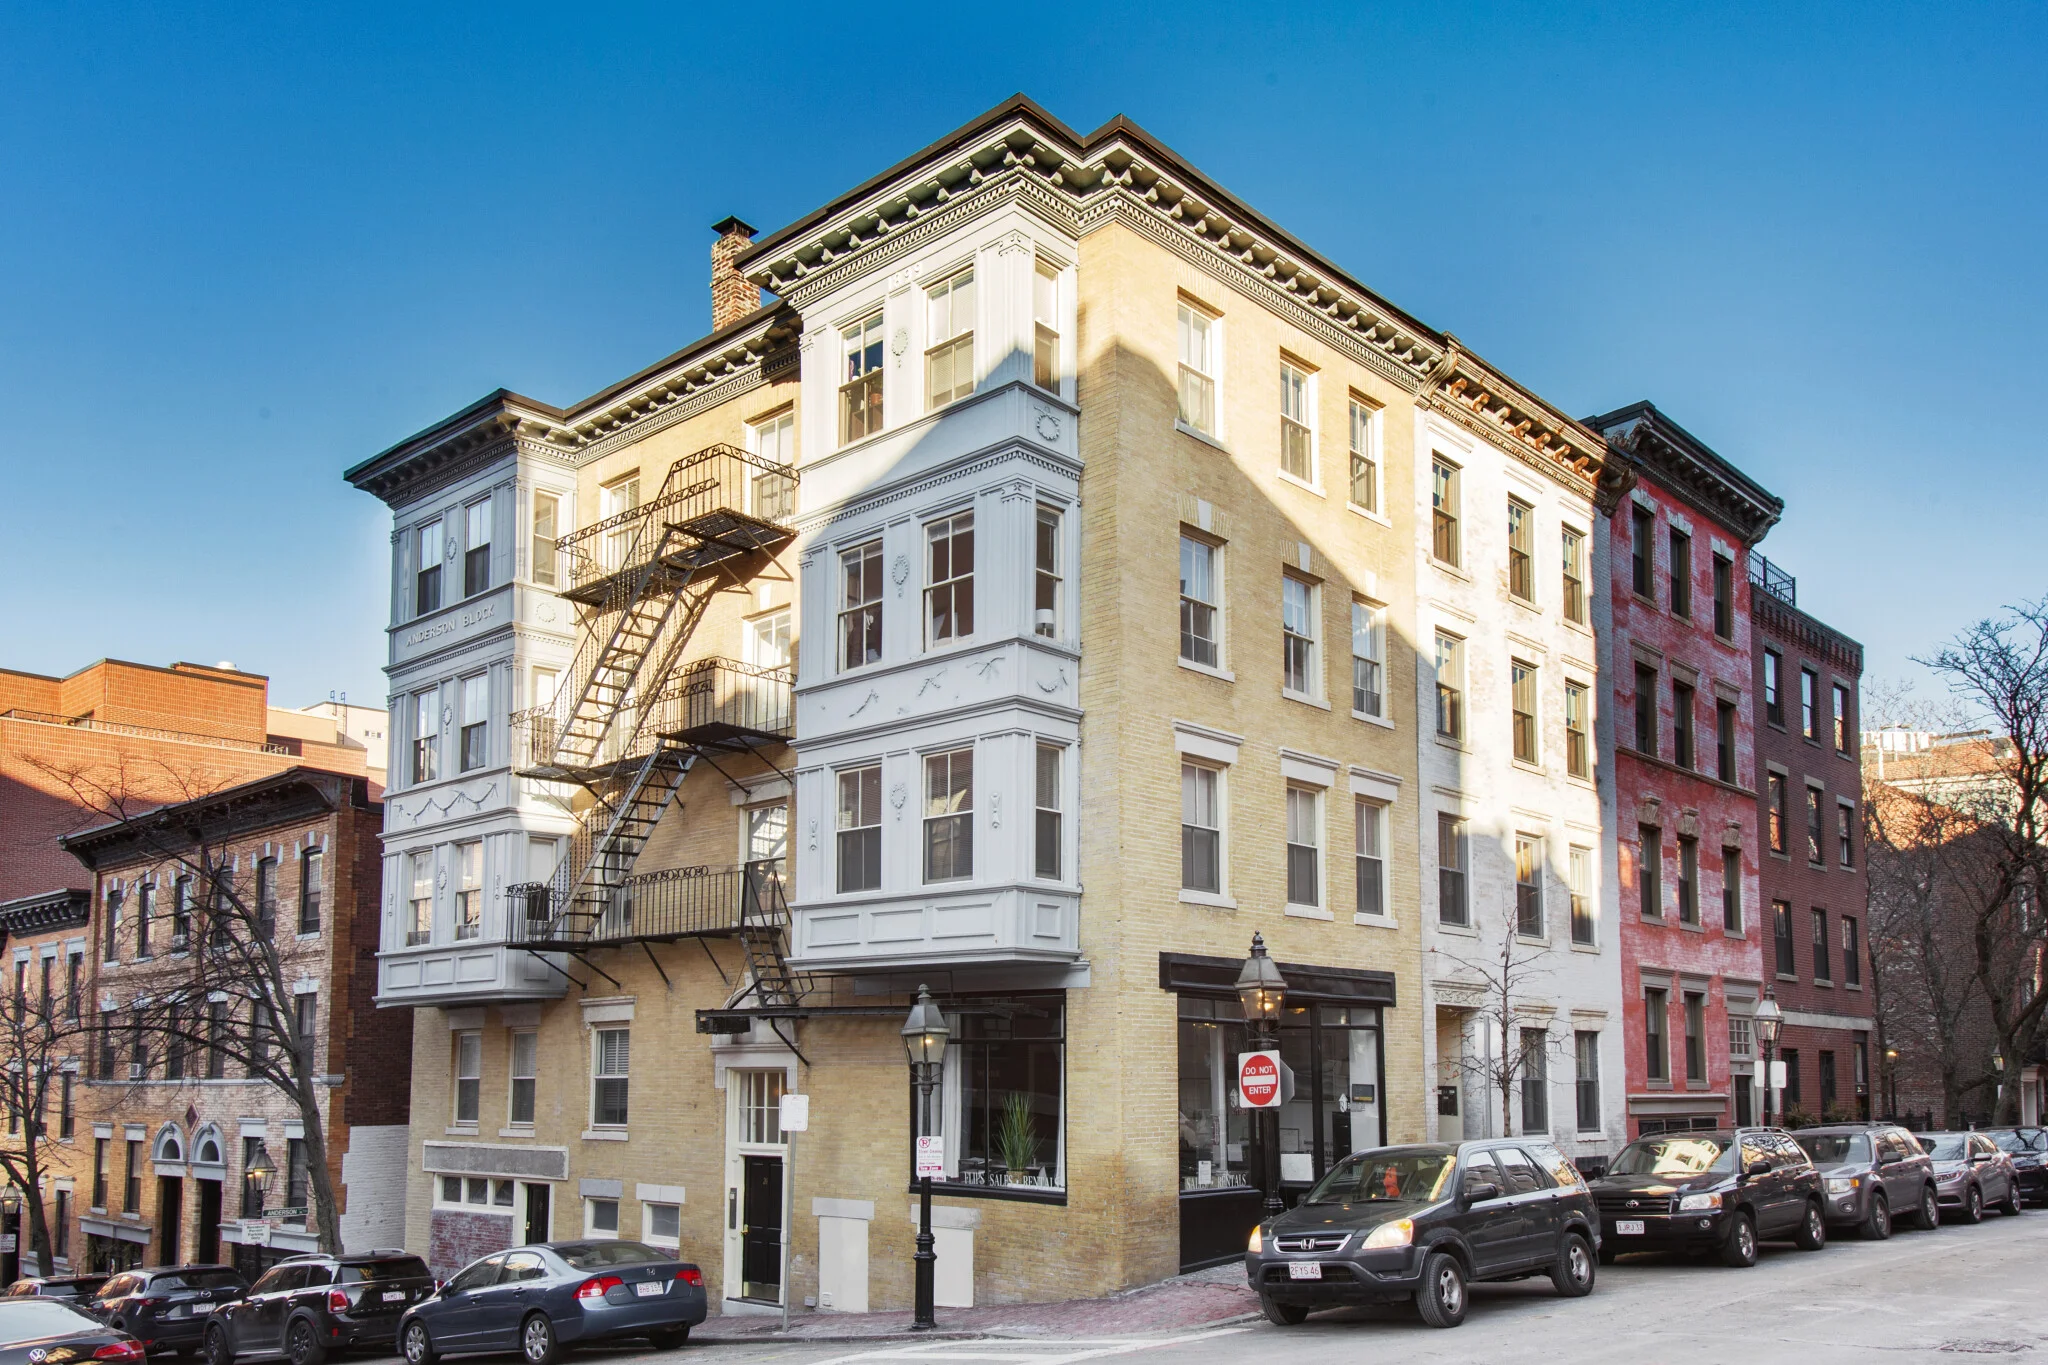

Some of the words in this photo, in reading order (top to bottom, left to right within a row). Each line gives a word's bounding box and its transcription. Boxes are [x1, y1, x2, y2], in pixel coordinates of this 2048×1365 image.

[406, 618, 456, 647] ANDERSON
[463, 603, 495, 628] BLOCK
[1245, 1066, 1256, 1075] DO
[1259, 1065, 1273, 1074] NOT
[1248, 1085, 1272, 1095] ENTER
[989, 1173, 1013, 1187] SALES
[1022, 1175, 1060, 1188] RENTALS
[267, 1208, 298, 1216] ANDERSON
[1310, 1266, 1320, 1275] 46
